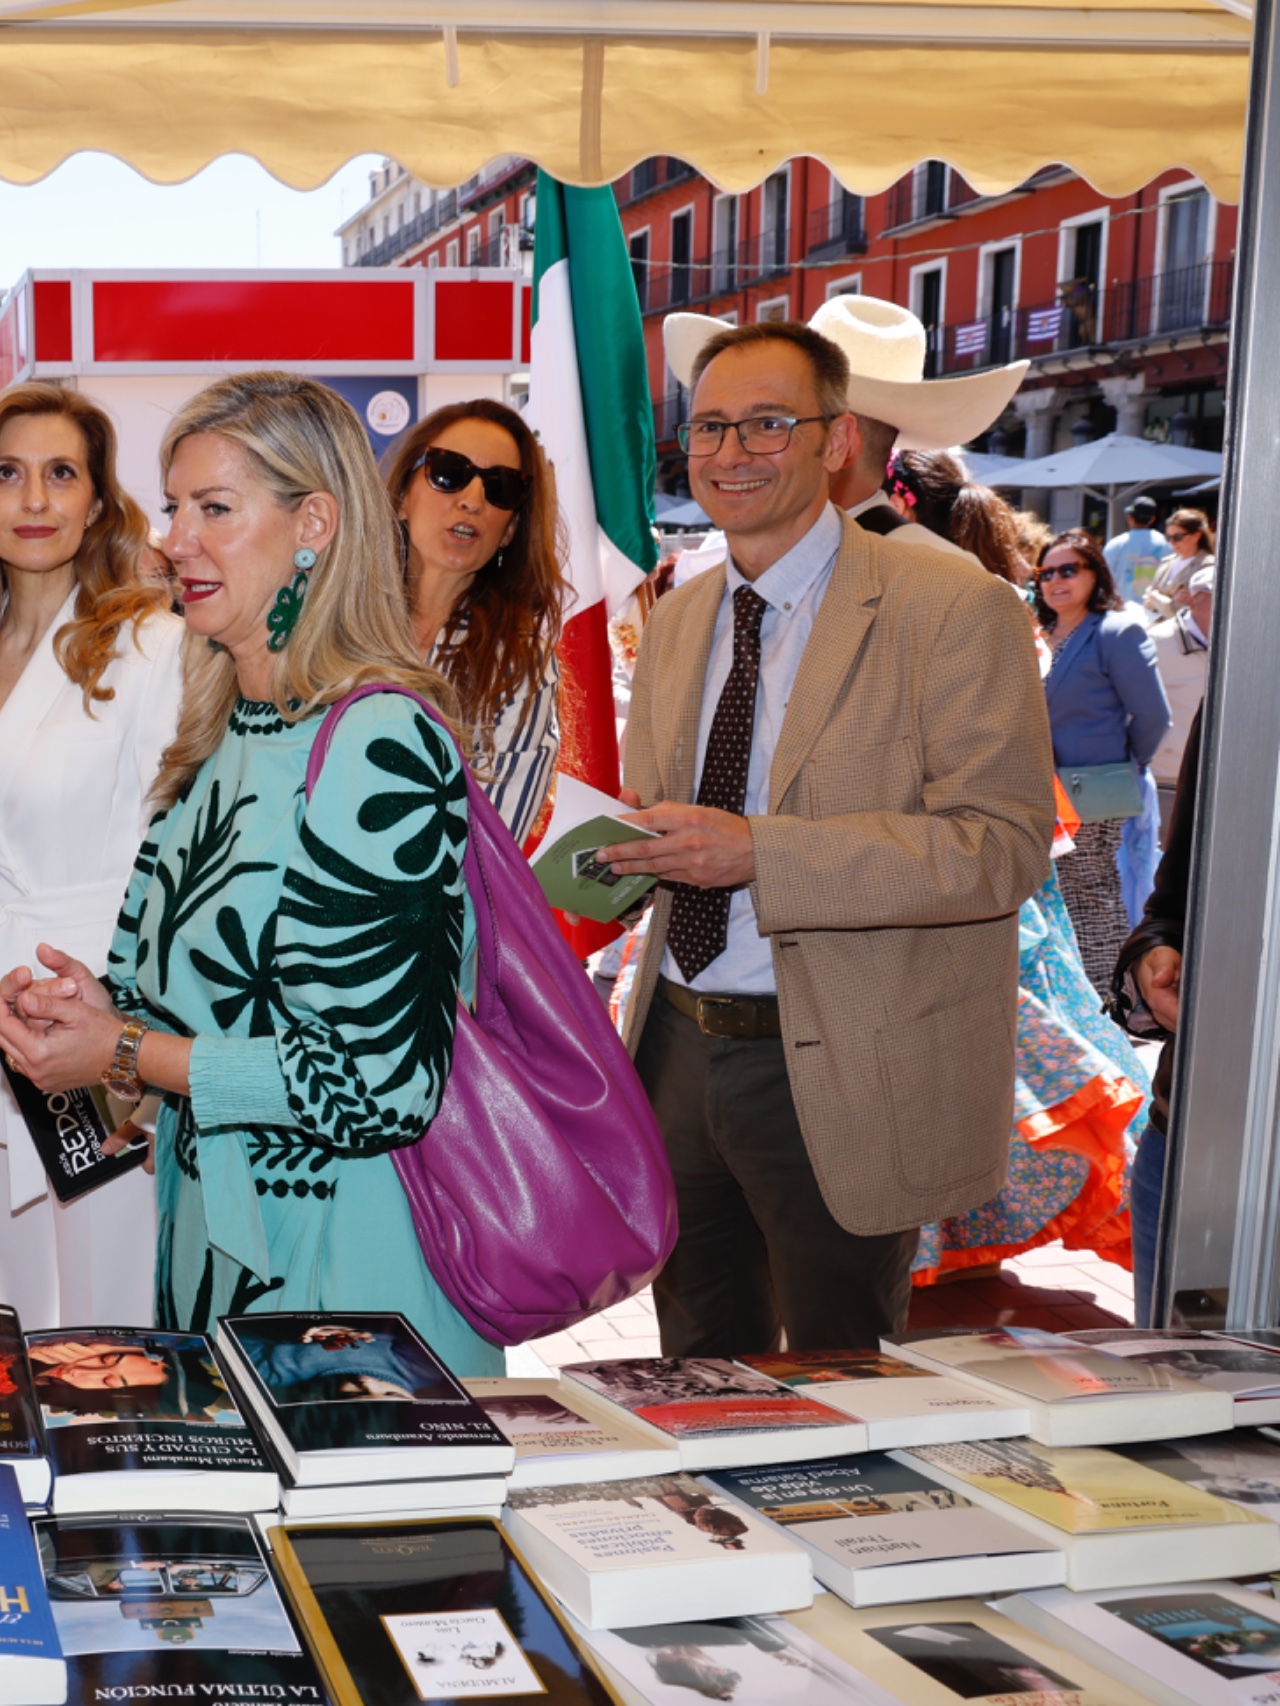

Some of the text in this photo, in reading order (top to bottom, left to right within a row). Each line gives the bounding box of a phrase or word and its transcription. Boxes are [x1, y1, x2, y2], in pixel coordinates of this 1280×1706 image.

[42, 1089, 96, 1176] REDO
[87, 1434, 253, 1445] MUROS INCIERTOS
[105, 1444, 258, 1455] LA CIUDAD Y SUS
[142, 1456, 264, 1466] Haruki Murakami
[738, 1472, 808, 1486] Salama
[808, 1467, 860, 1480] Abed
[750, 1480, 821, 1494] vida de
[762, 1484, 874, 1501] Un día en la
[1100, 1500, 1169, 1508] Fortuna
[569, 1525, 644, 1538] privadas
[577, 1530, 673, 1544] emociones
[584, 1537, 666, 1551] públicas,
[834, 1534, 893, 1546] Thrall
[594, 1545, 675, 1558] Pasiones
[848, 1540, 921, 1555] Nathan
[400, 1618, 448, 1627] Montero
[436, 1677, 516, 1688] ALMUDENA
[94, 1684, 319, 1700] LA ÚLTIMA FUNCIÓN
